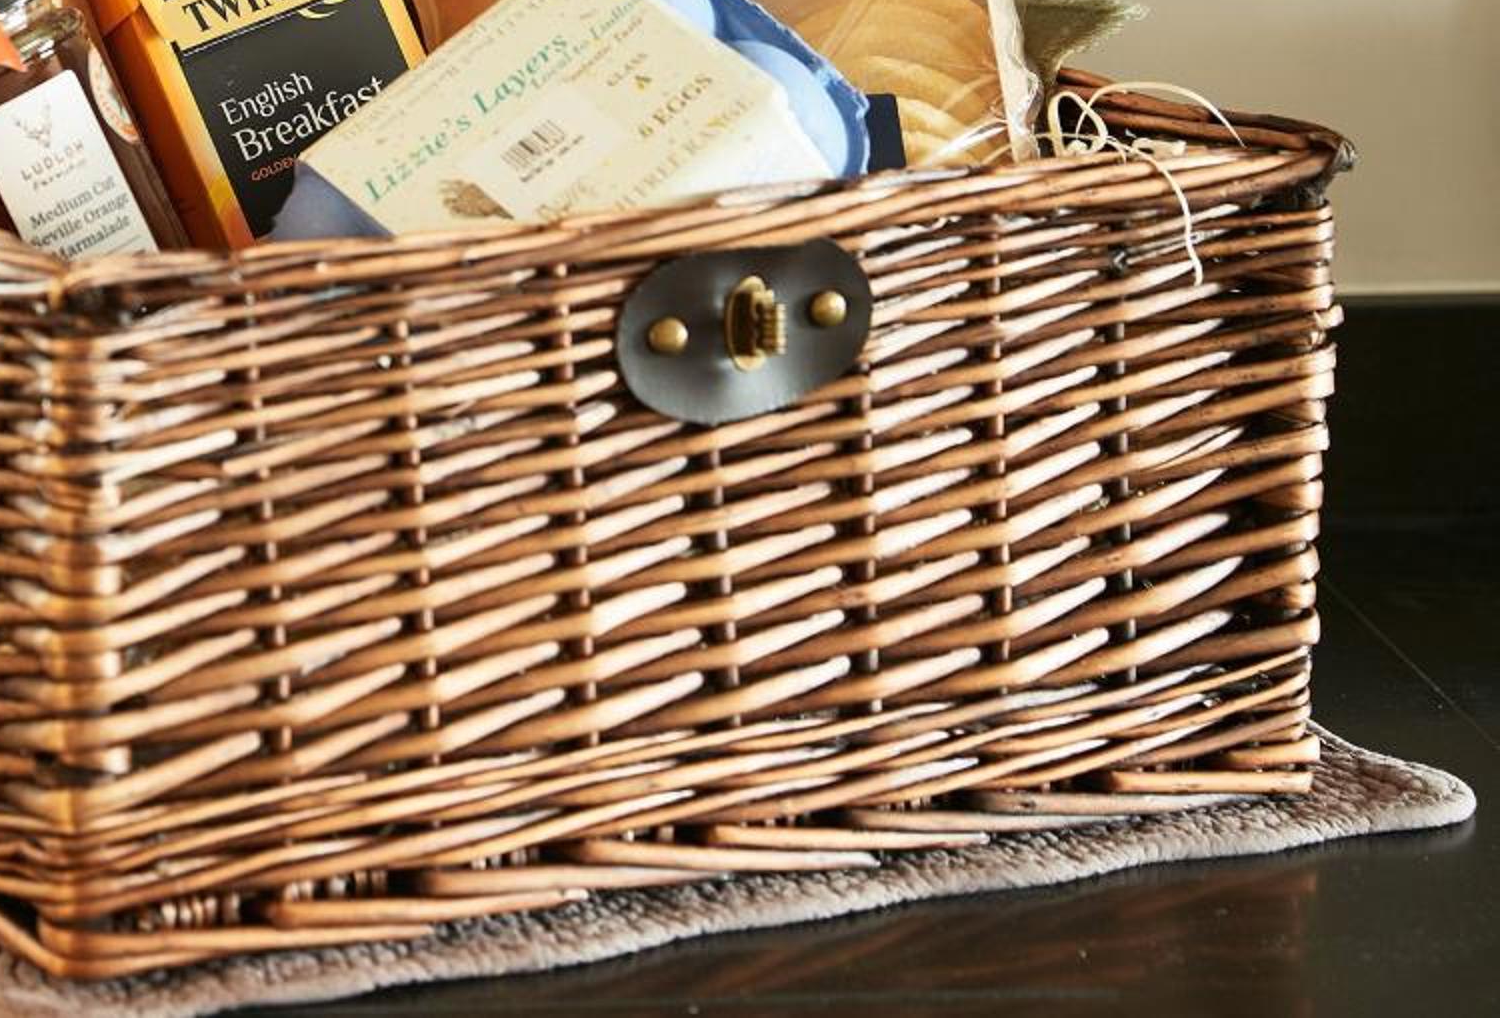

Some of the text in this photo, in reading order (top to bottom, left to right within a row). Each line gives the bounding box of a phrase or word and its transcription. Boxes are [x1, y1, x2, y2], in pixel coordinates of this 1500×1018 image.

[219, 72, 314, 125] English
[231, 75, 383, 162] Breakfast
[365, 113, 473, 201] Lizzie's
[472, 35, 568, 114] Layers
[652, 72, 713, 126] EGGS
[21, 139, 84, 181] LUDLOW
[29, 190, 92, 229] Medium
[84, 193, 129, 225] Orange
